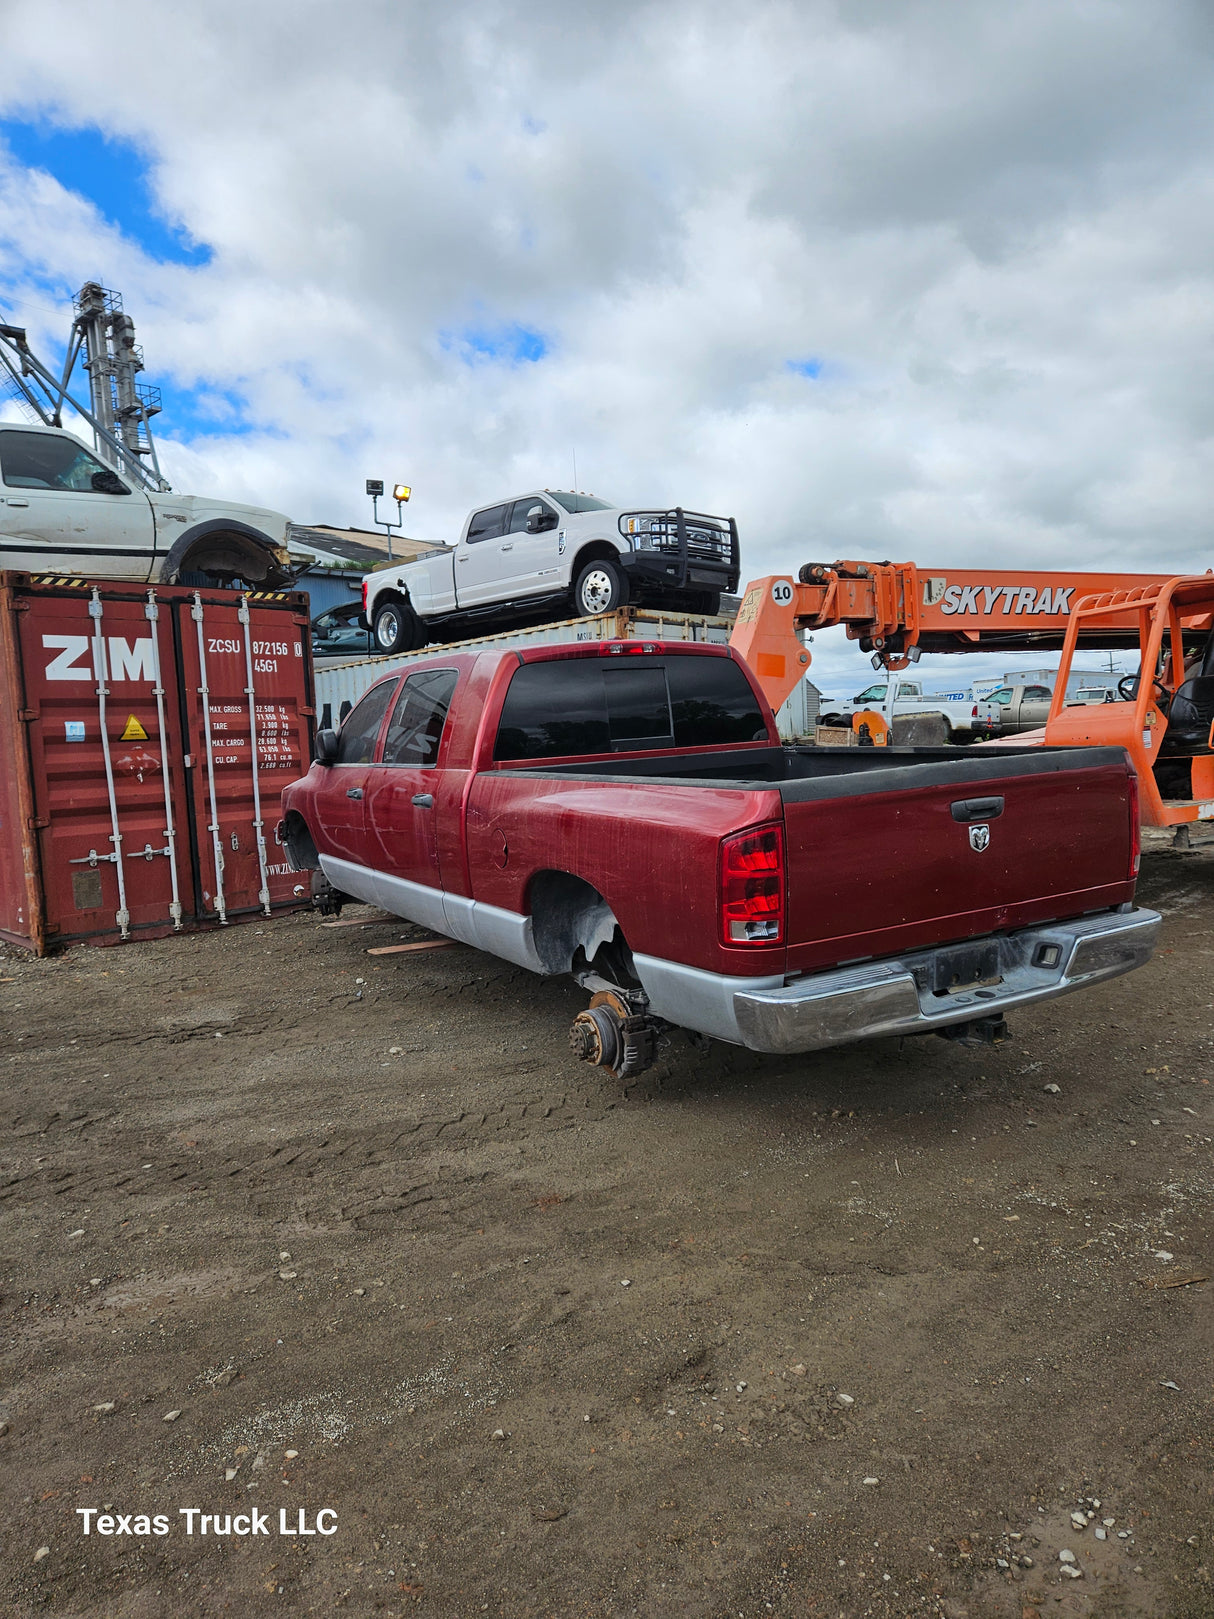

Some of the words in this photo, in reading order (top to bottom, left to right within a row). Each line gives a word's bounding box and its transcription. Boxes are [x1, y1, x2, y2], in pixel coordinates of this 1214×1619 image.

[774, 586, 791, 600] 10
[940, 584, 1076, 616] SKYTRAK
[207, 638, 241, 654] ZCSU
[252, 641, 288, 656] 872156
[42, 634, 158, 681] ZIM
[254, 659, 278, 673] 45G1
[223, 705, 242, 714] GROSS
[278, 705, 286, 714] kg
[212, 722, 228, 730] TARE
[282, 721, 289, 730] kg
[280, 737, 288, 746] kg
